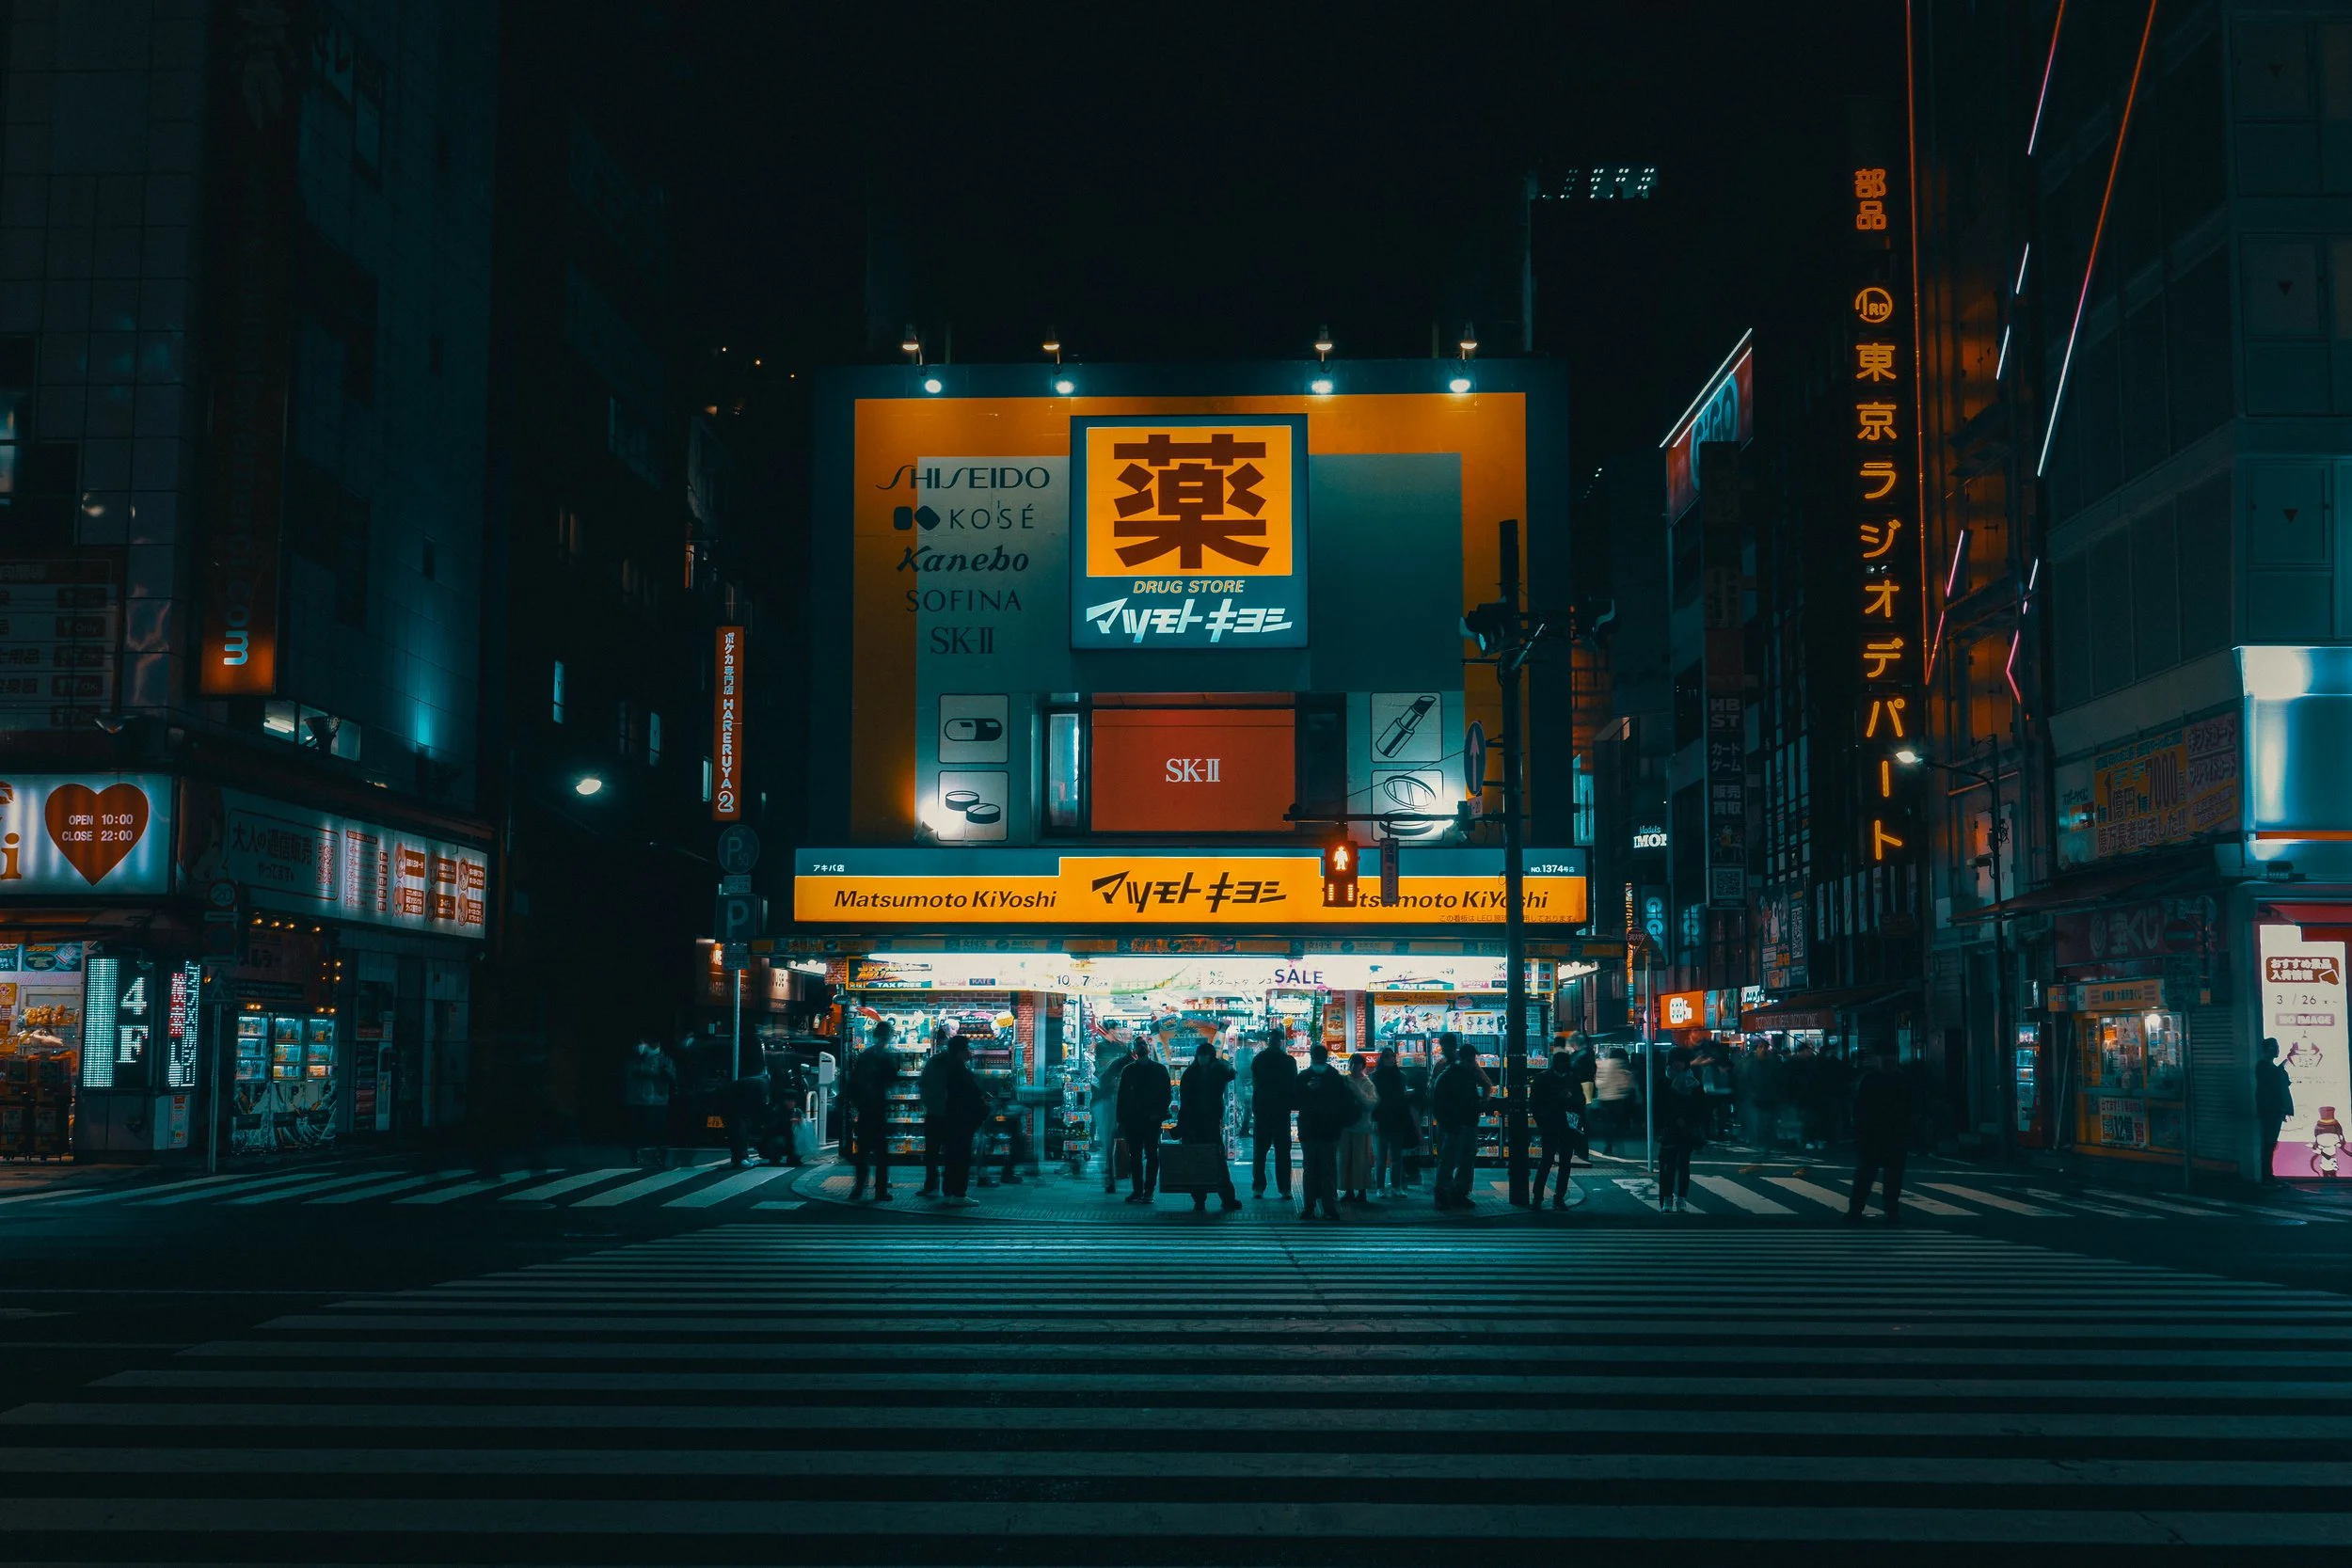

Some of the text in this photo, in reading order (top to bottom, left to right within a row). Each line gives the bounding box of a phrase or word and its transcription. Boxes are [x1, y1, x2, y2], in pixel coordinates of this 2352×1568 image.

[1854, 168, 1886, 230] 部品
[876, 465, 1051, 490] SHISEIDO
[1114, 433, 1271, 570] 薬
[950, 503, 1035, 530] KOSÉ
[896, 545, 1029, 573] Kanebo
[1133, 579, 1246, 594] DRUG STORE
[906, 589, 1022, 612] SOFINA
[1855, 342, 1905, 861] 東京ラジオデパート
[1086, 597, 1294, 643] マツモトキヨシ
[930, 626, 993, 655] SK-II
[717, 698, 735, 813] HARERUYA 2
[1712, 743, 1741, 756] カード
[1165, 758, 1221, 784] SK-II
[1712, 758, 1741, 773] ゲーム
[1712, 784, 1741, 799] 販売
[68, 814, 134, 826] OPEN 10:00
[1713, 801, 1742, 816] 買取
[61, 831, 134, 842] CLOSE 22:00
[231, 819, 313, 865] 大人の通信販売
[727, 836, 743, 866] P
[813, 863, 845, 873] アキバ店
[213, 887, 233, 902] 20
[834, 889, 1060, 909] Matsumoto KiYoshi
[1091, 870, 1288, 913] マツモトキヨシ
[725, 899, 750, 940] P
[1476, 914, 1493, 923] LED
[1274, 969, 1324, 985] SALE
[2301, 994, 2317, 1006] 26
